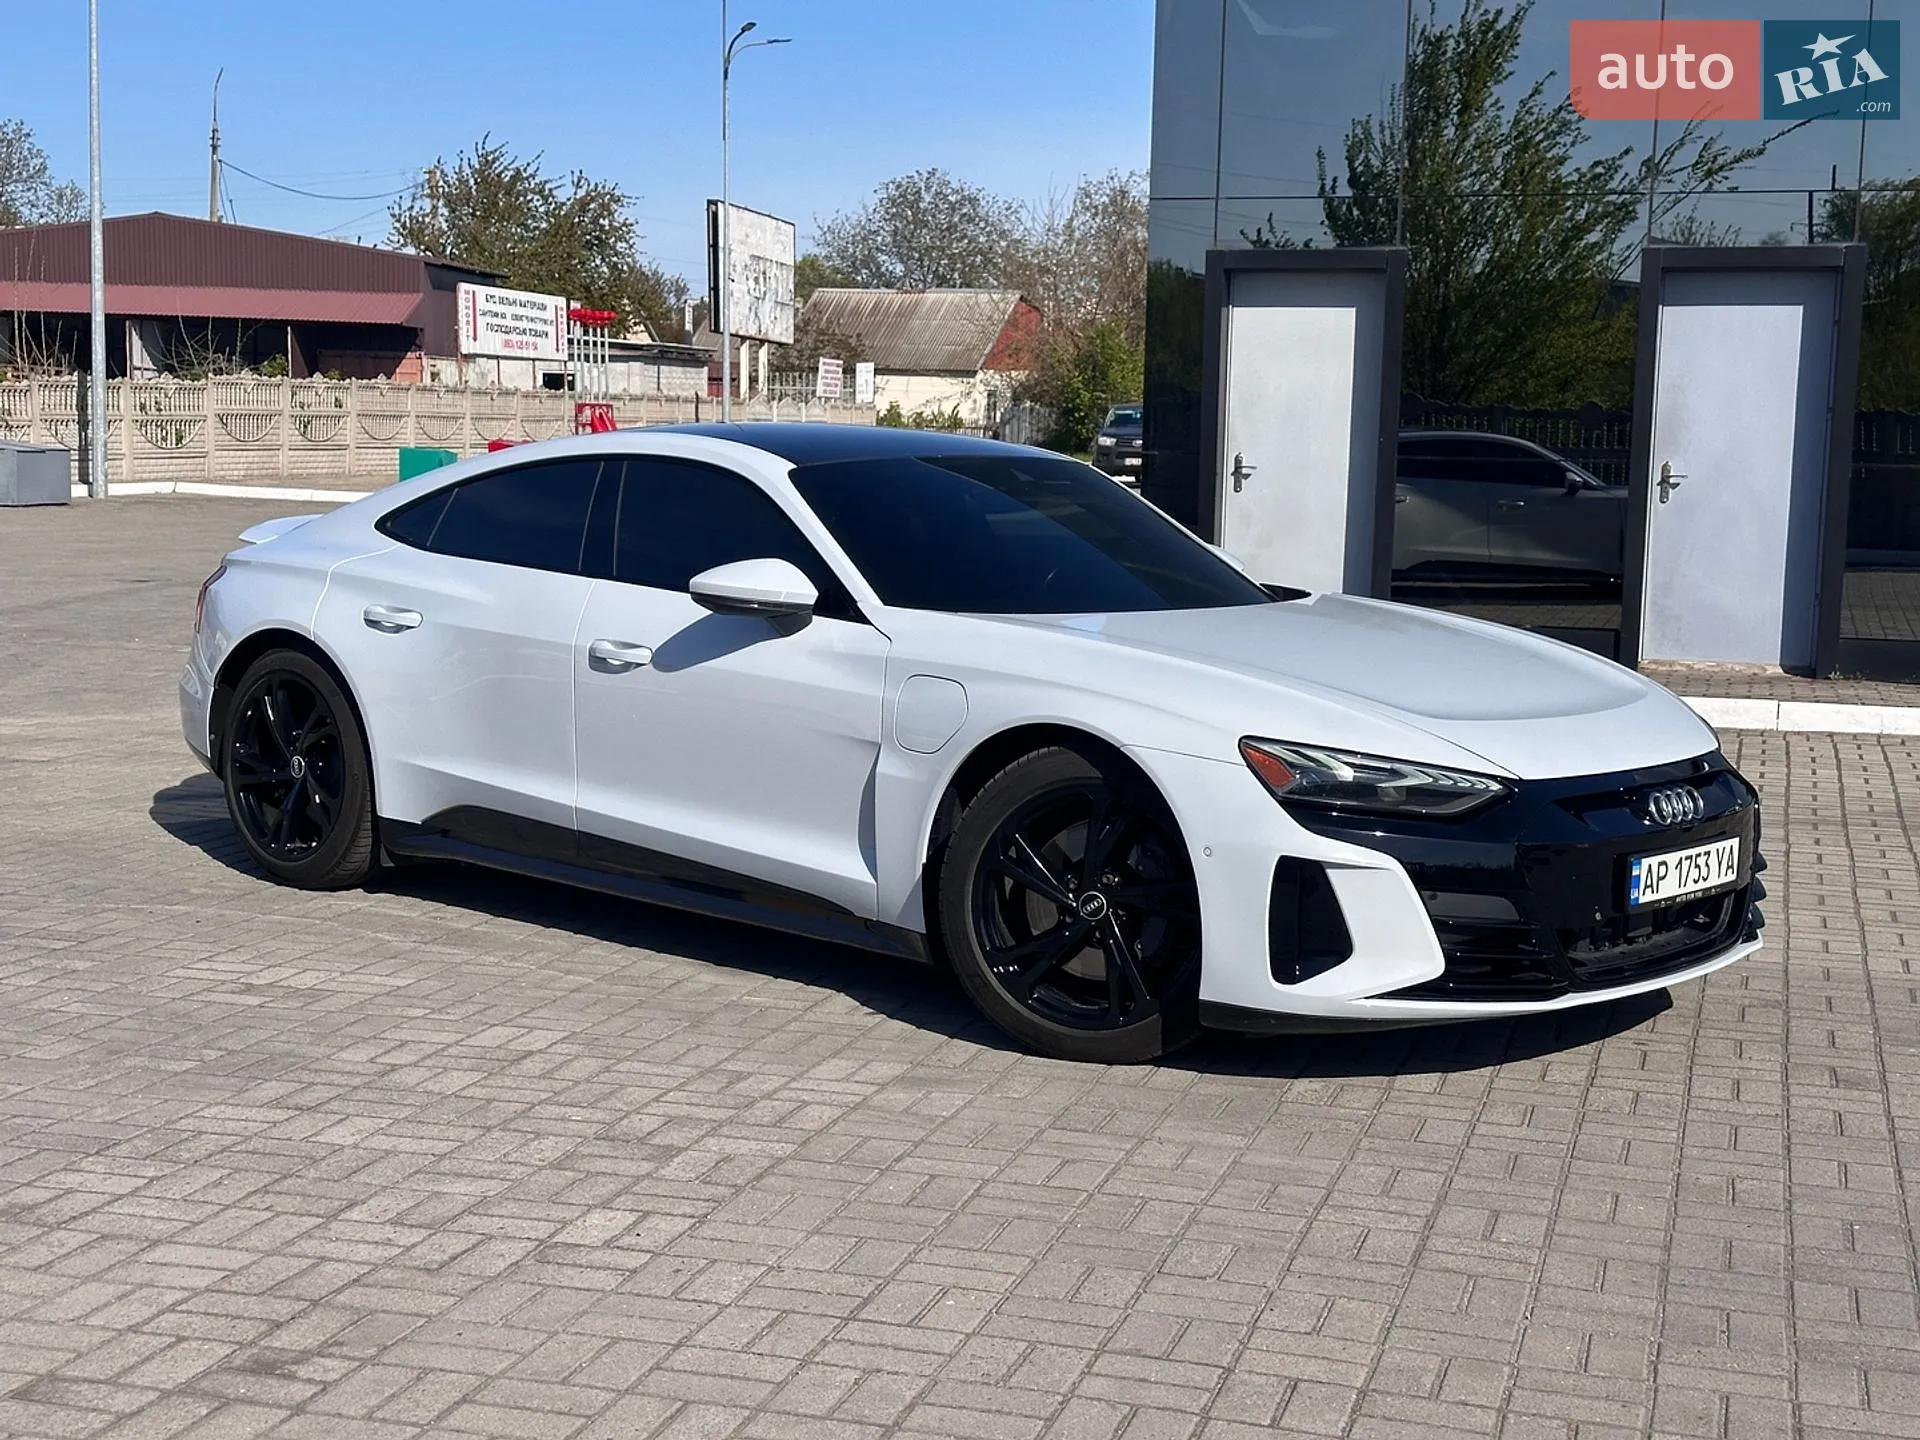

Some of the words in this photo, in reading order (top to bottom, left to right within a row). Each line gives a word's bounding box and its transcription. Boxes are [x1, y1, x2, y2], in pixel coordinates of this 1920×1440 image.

[1642, 860, 1669, 896] AP
[1675, 850, 1711, 889] 1753
[1716, 844, 1735, 879] YA
[1630, 887, 1639, 898] UA
